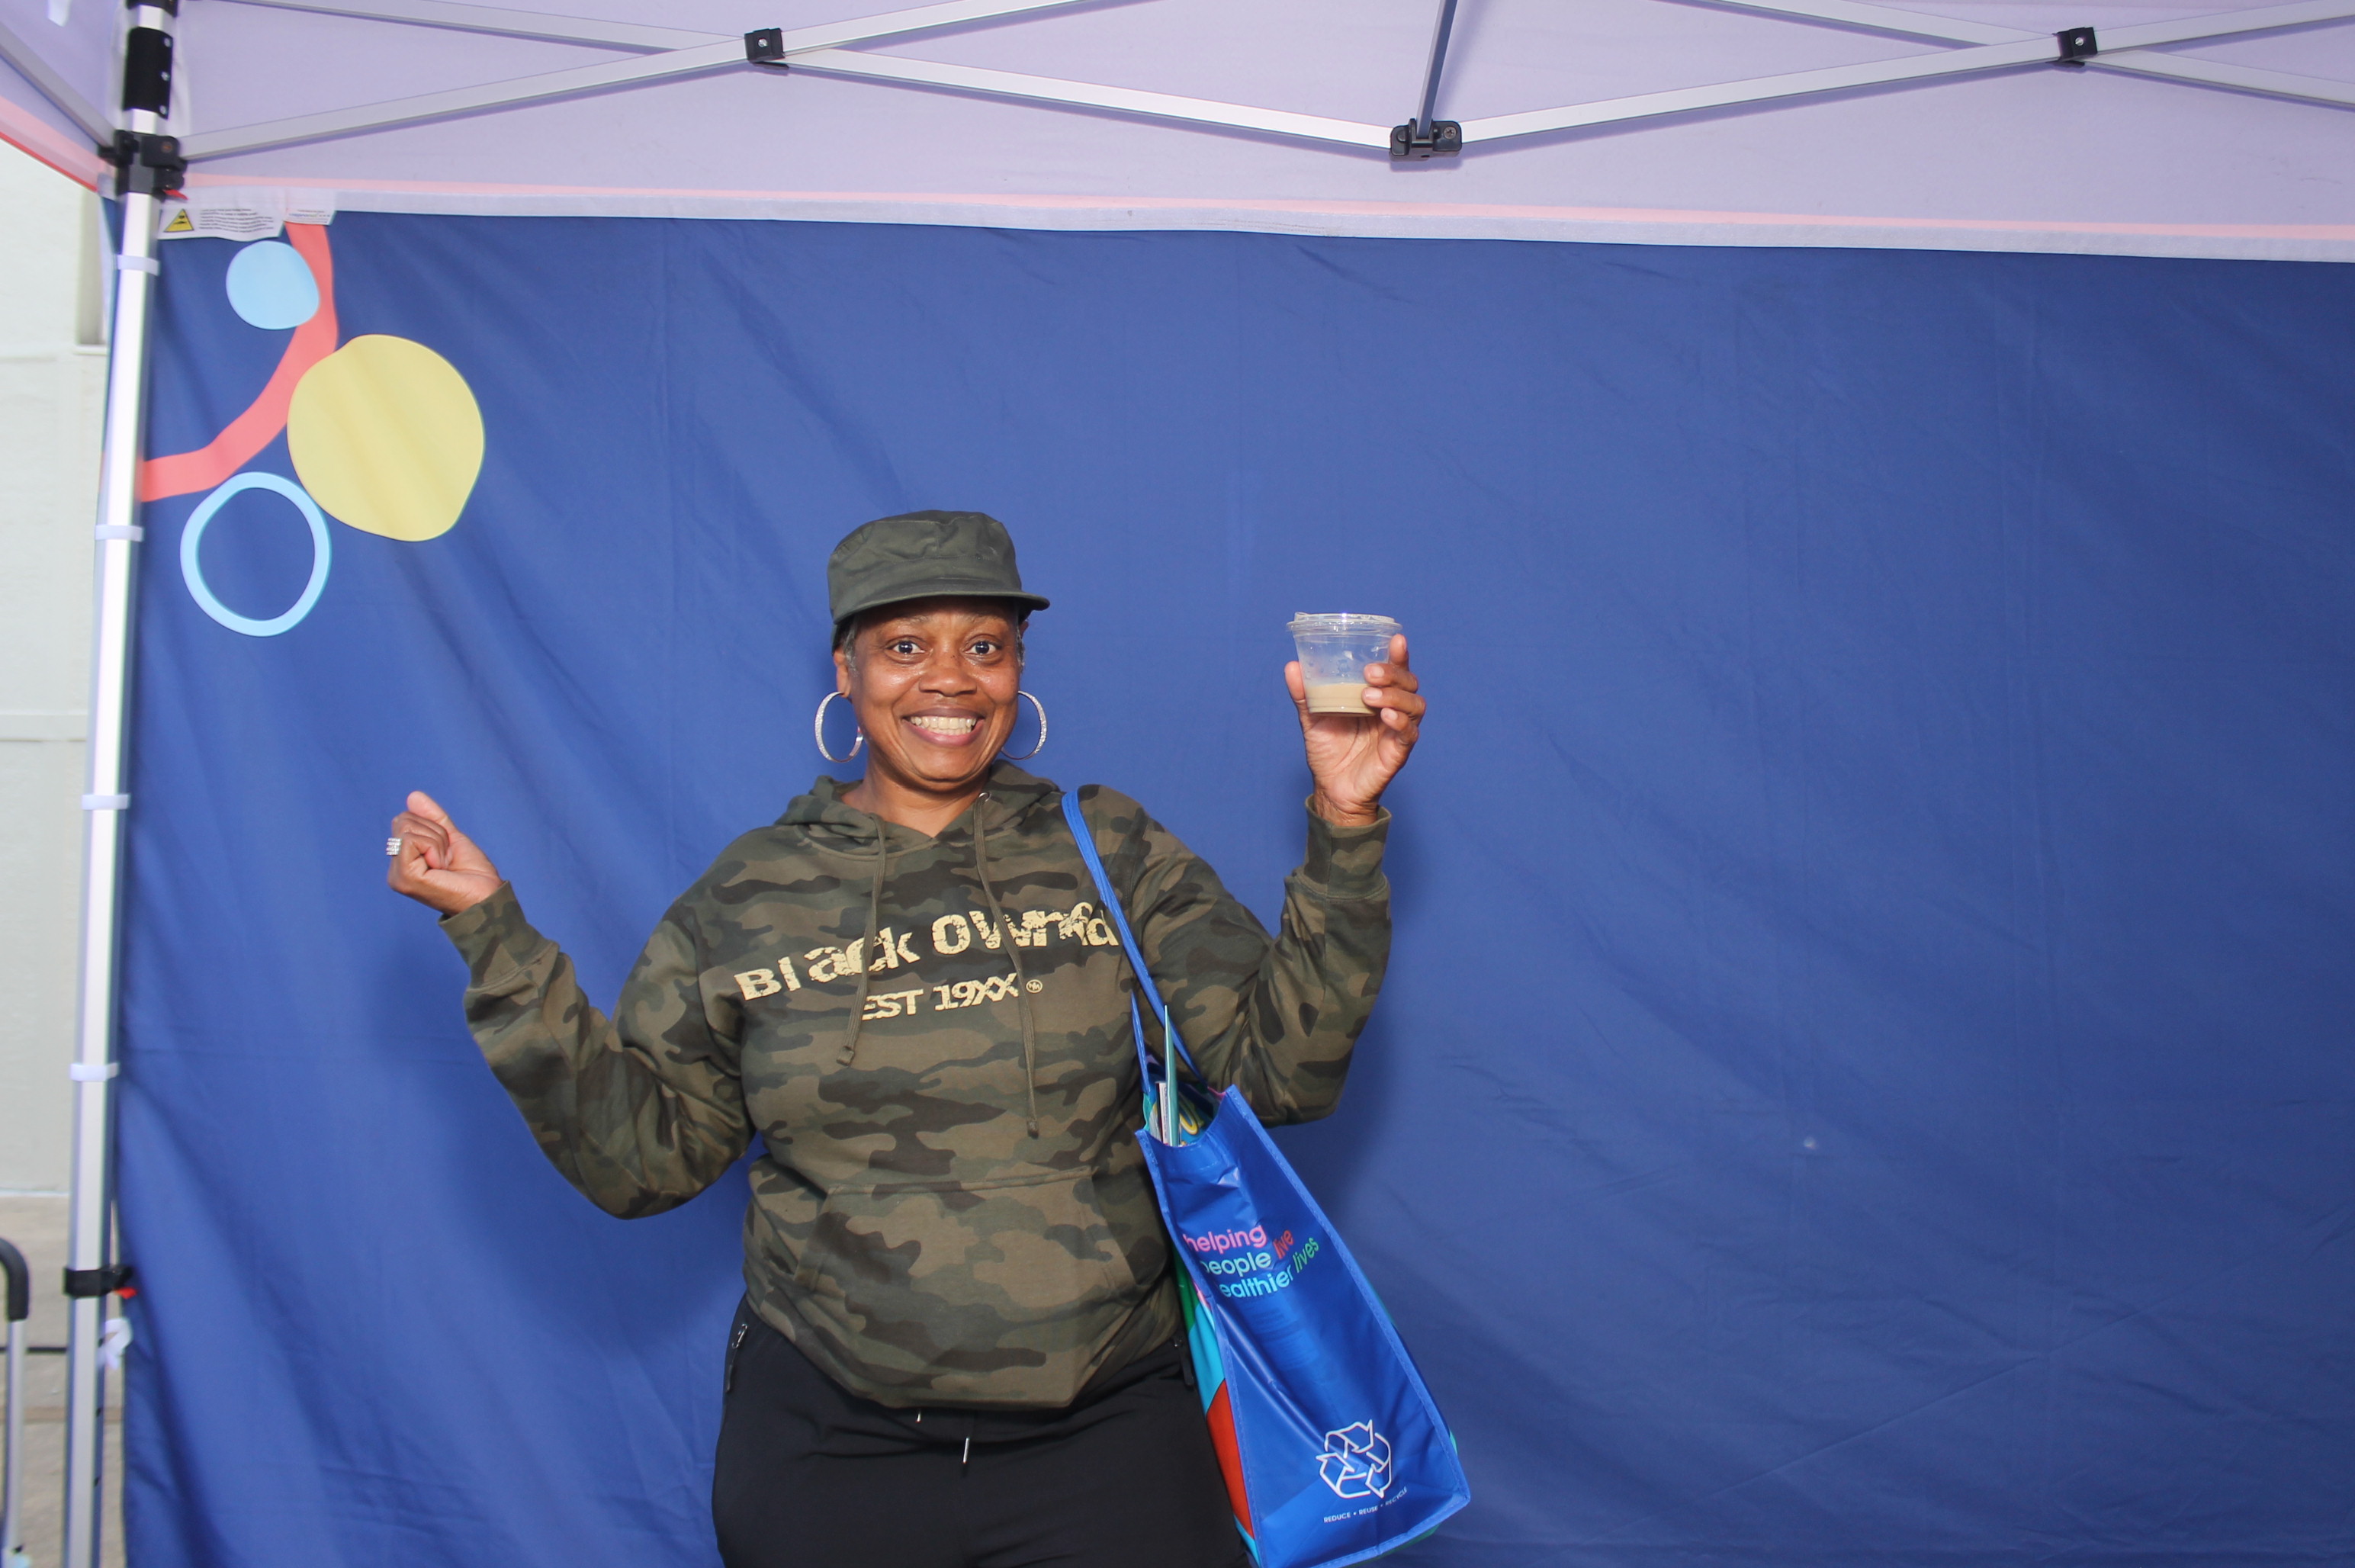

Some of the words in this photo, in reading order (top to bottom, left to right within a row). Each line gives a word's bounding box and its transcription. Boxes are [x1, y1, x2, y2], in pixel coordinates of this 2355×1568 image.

[734, 927, 921, 1001] Black
[862, 988, 924, 1020] EST
[933, 972, 1019, 1011] 19XX
[1182, 1225, 1267, 1255] helping
[1271, 1229, 1295, 1259] live
[1219, 1264, 1294, 1298] ealthier
[1293, 1236, 1320, 1274] lives
[1323, 1512, 1351, 1524] REDUCE
[1358, 1505, 1379, 1515] REUSE
